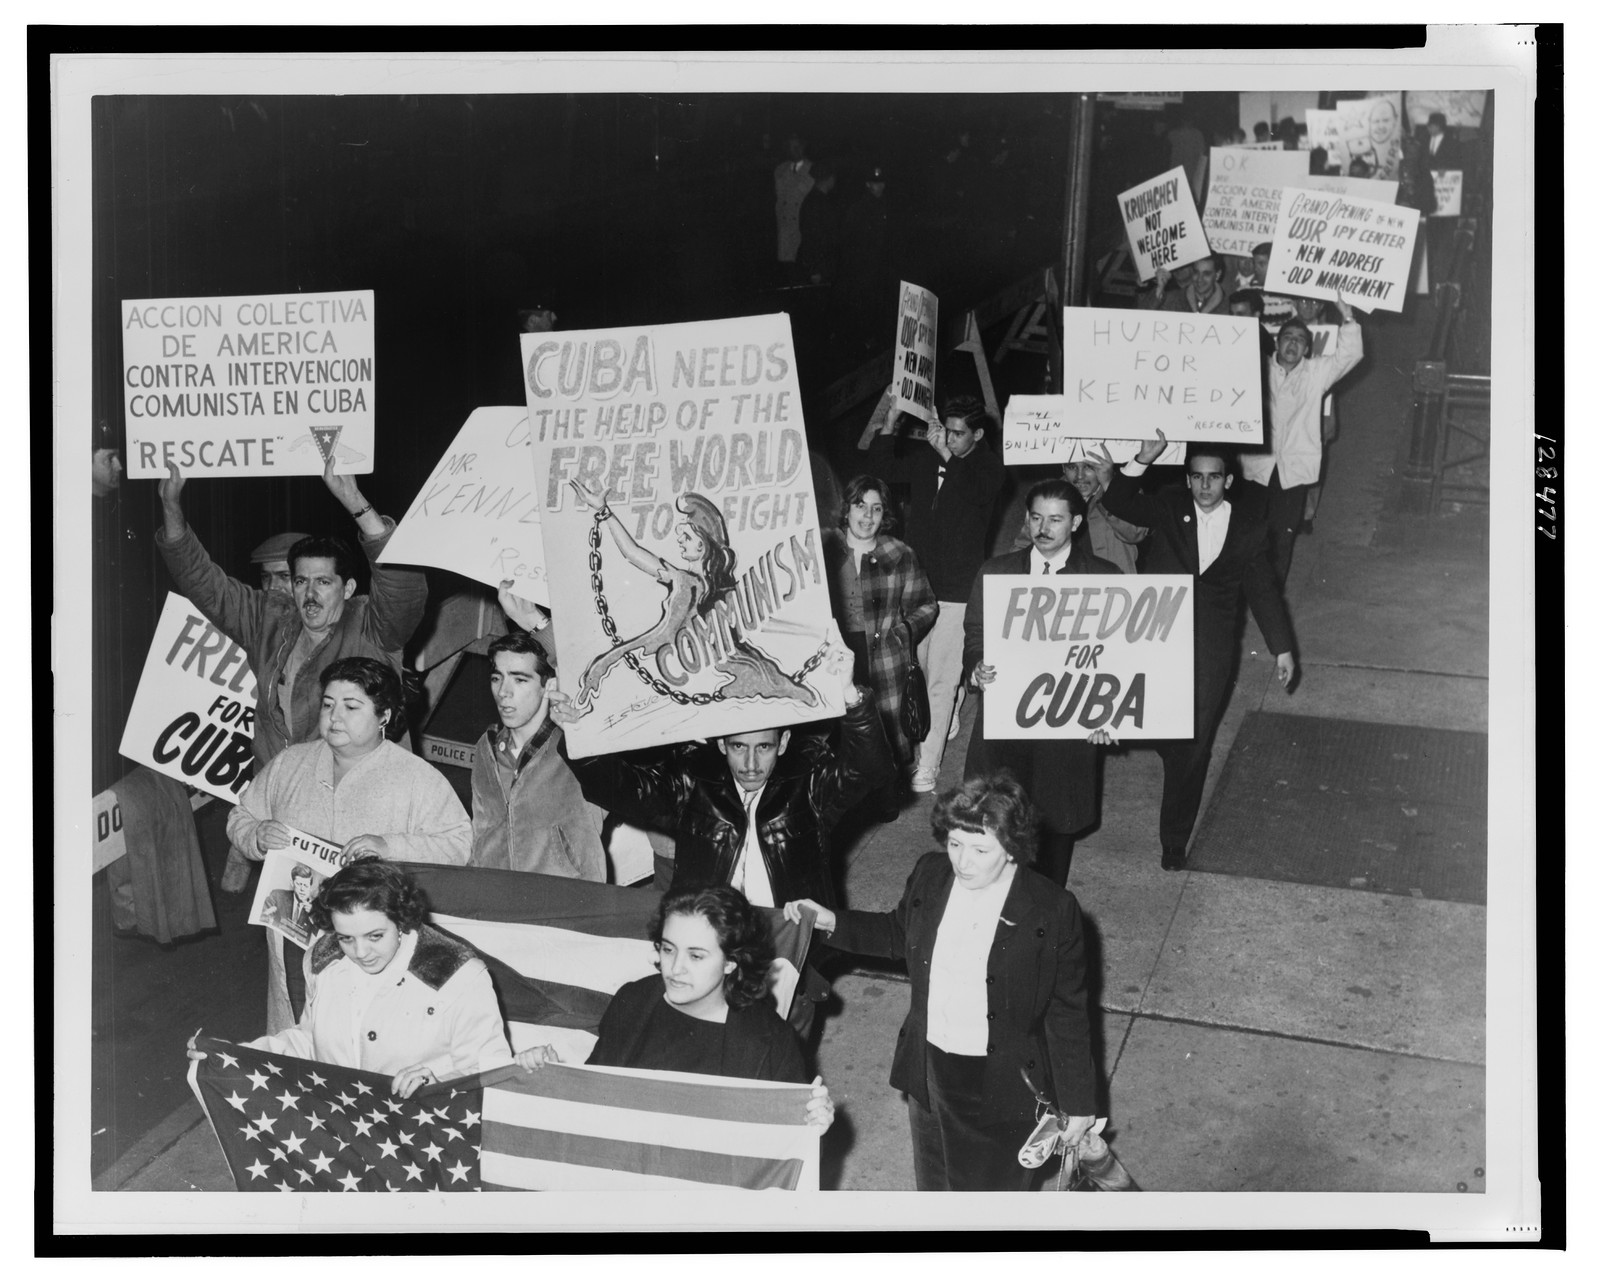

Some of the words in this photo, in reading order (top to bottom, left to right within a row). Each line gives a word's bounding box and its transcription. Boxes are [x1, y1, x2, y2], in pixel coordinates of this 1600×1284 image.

[1124, 178, 1178, 223] KRUSHCHEV
[1210, 184, 1247, 196] ACCION
[1220, 196, 1233, 207] DE
[1145, 211, 1161, 232] NOT
[1204, 207, 1237, 218] CONTRA
[1288, 192, 1329, 218] GRAND
[1326, 198, 1374, 222] OPENING
[1137, 221, 1187, 255] WELCOME
[1203, 219, 1254, 233] COMUNISTA
[1258, 223, 1269, 234] EN
[1288, 216, 1328, 243] USSR
[1332, 224, 1358, 240] SPY
[1358, 229, 1406, 249] CENTER
[1151, 243, 1178, 269] HERE
[1295, 244, 1326, 264] NEW
[1328, 249, 1384, 274] ADDRESS
[1287, 266, 1313, 285] OLD
[1315, 270, 1395, 300] MANAGEMENT
[126, 304, 222, 329] ACCION
[237, 299, 367, 326] COLECTIVA
[162, 334, 196, 358] DE
[217, 330, 338, 357] AMERICA
[1094, 320, 1247, 346] HURRAY
[126, 364, 216, 388] CONTRA
[228, 358, 372, 386] INTERVENCION
[527, 335, 657, 401] CUBA
[672, 342, 789, 388] NEEDS
[1134, 351, 1197, 372] FOR
[130, 391, 265, 417] COMUNISTA
[274, 391, 298, 415] EN
[308, 388, 367, 413] CUBA
[1078, 379, 1246, 407] KENNEDY
[536, 408, 588, 442] THE
[594, 401, 669, 441] HELP
[676, 398, 720, 432] OF
[731, 391, 791, 425] THE
[434, 453, 478, 480] MR.
[546, 441, 661, 512] FREE
[669, 428, 803, 494] WORLD
[1533, 432, 1559, 540] 128477
[631, 502, 674, 542] TO
[722, 491, 809, 532] FIGHT
[656, 528, 822, 687] COMMUNISM
[1002, 585, 1188, 644] FREEDOM
[165, 614, 258, 700] FRE
[1064, 644, 1105, 669] FOR
[207, 695, 255, 732] FOR
[1015, 671, 1146, 730] CUBA
[431, 744, 466, 761] POLICE
